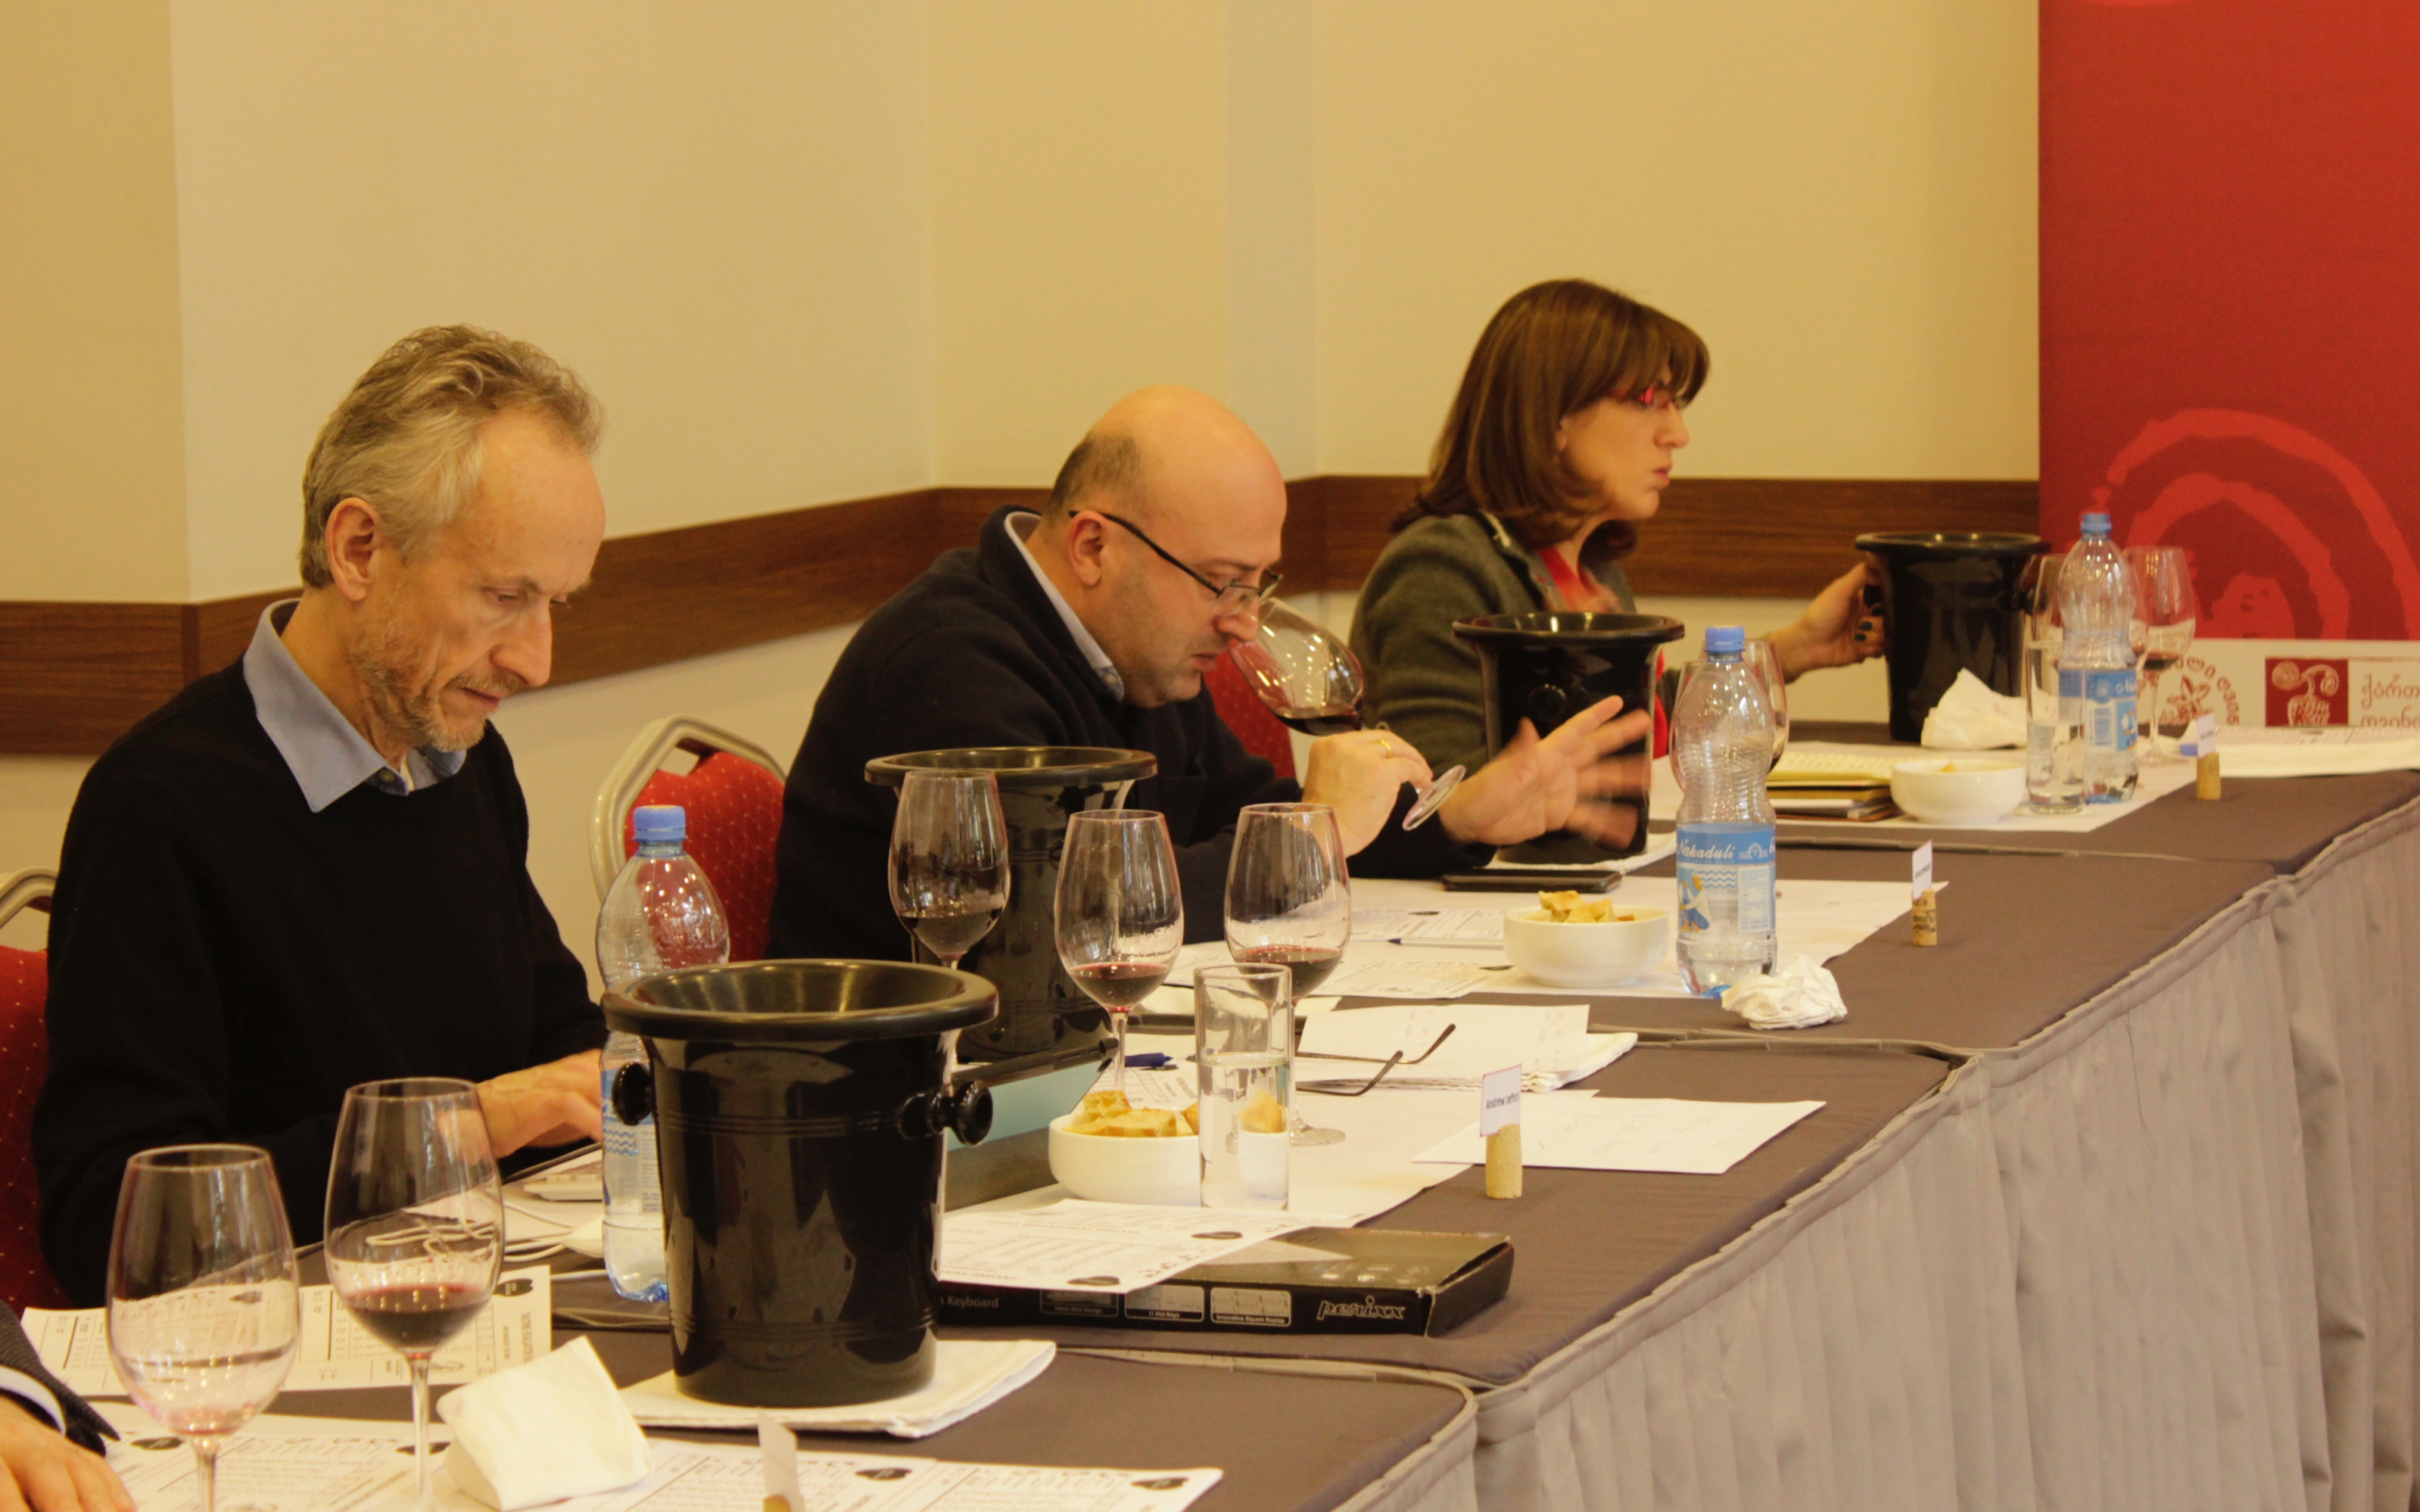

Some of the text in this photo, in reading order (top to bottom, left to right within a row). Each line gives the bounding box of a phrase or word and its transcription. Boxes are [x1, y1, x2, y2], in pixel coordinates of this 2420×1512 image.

[1677, 838, 1736, 859] Nakaduli
[1486, 1098, 1505, 1109] Andrew
[948, 1295, 999, 1308] Keyboard
[1317, 1296, 1406, 1321] perixx
[1216, 1313, 1244, 1321] Innovative
